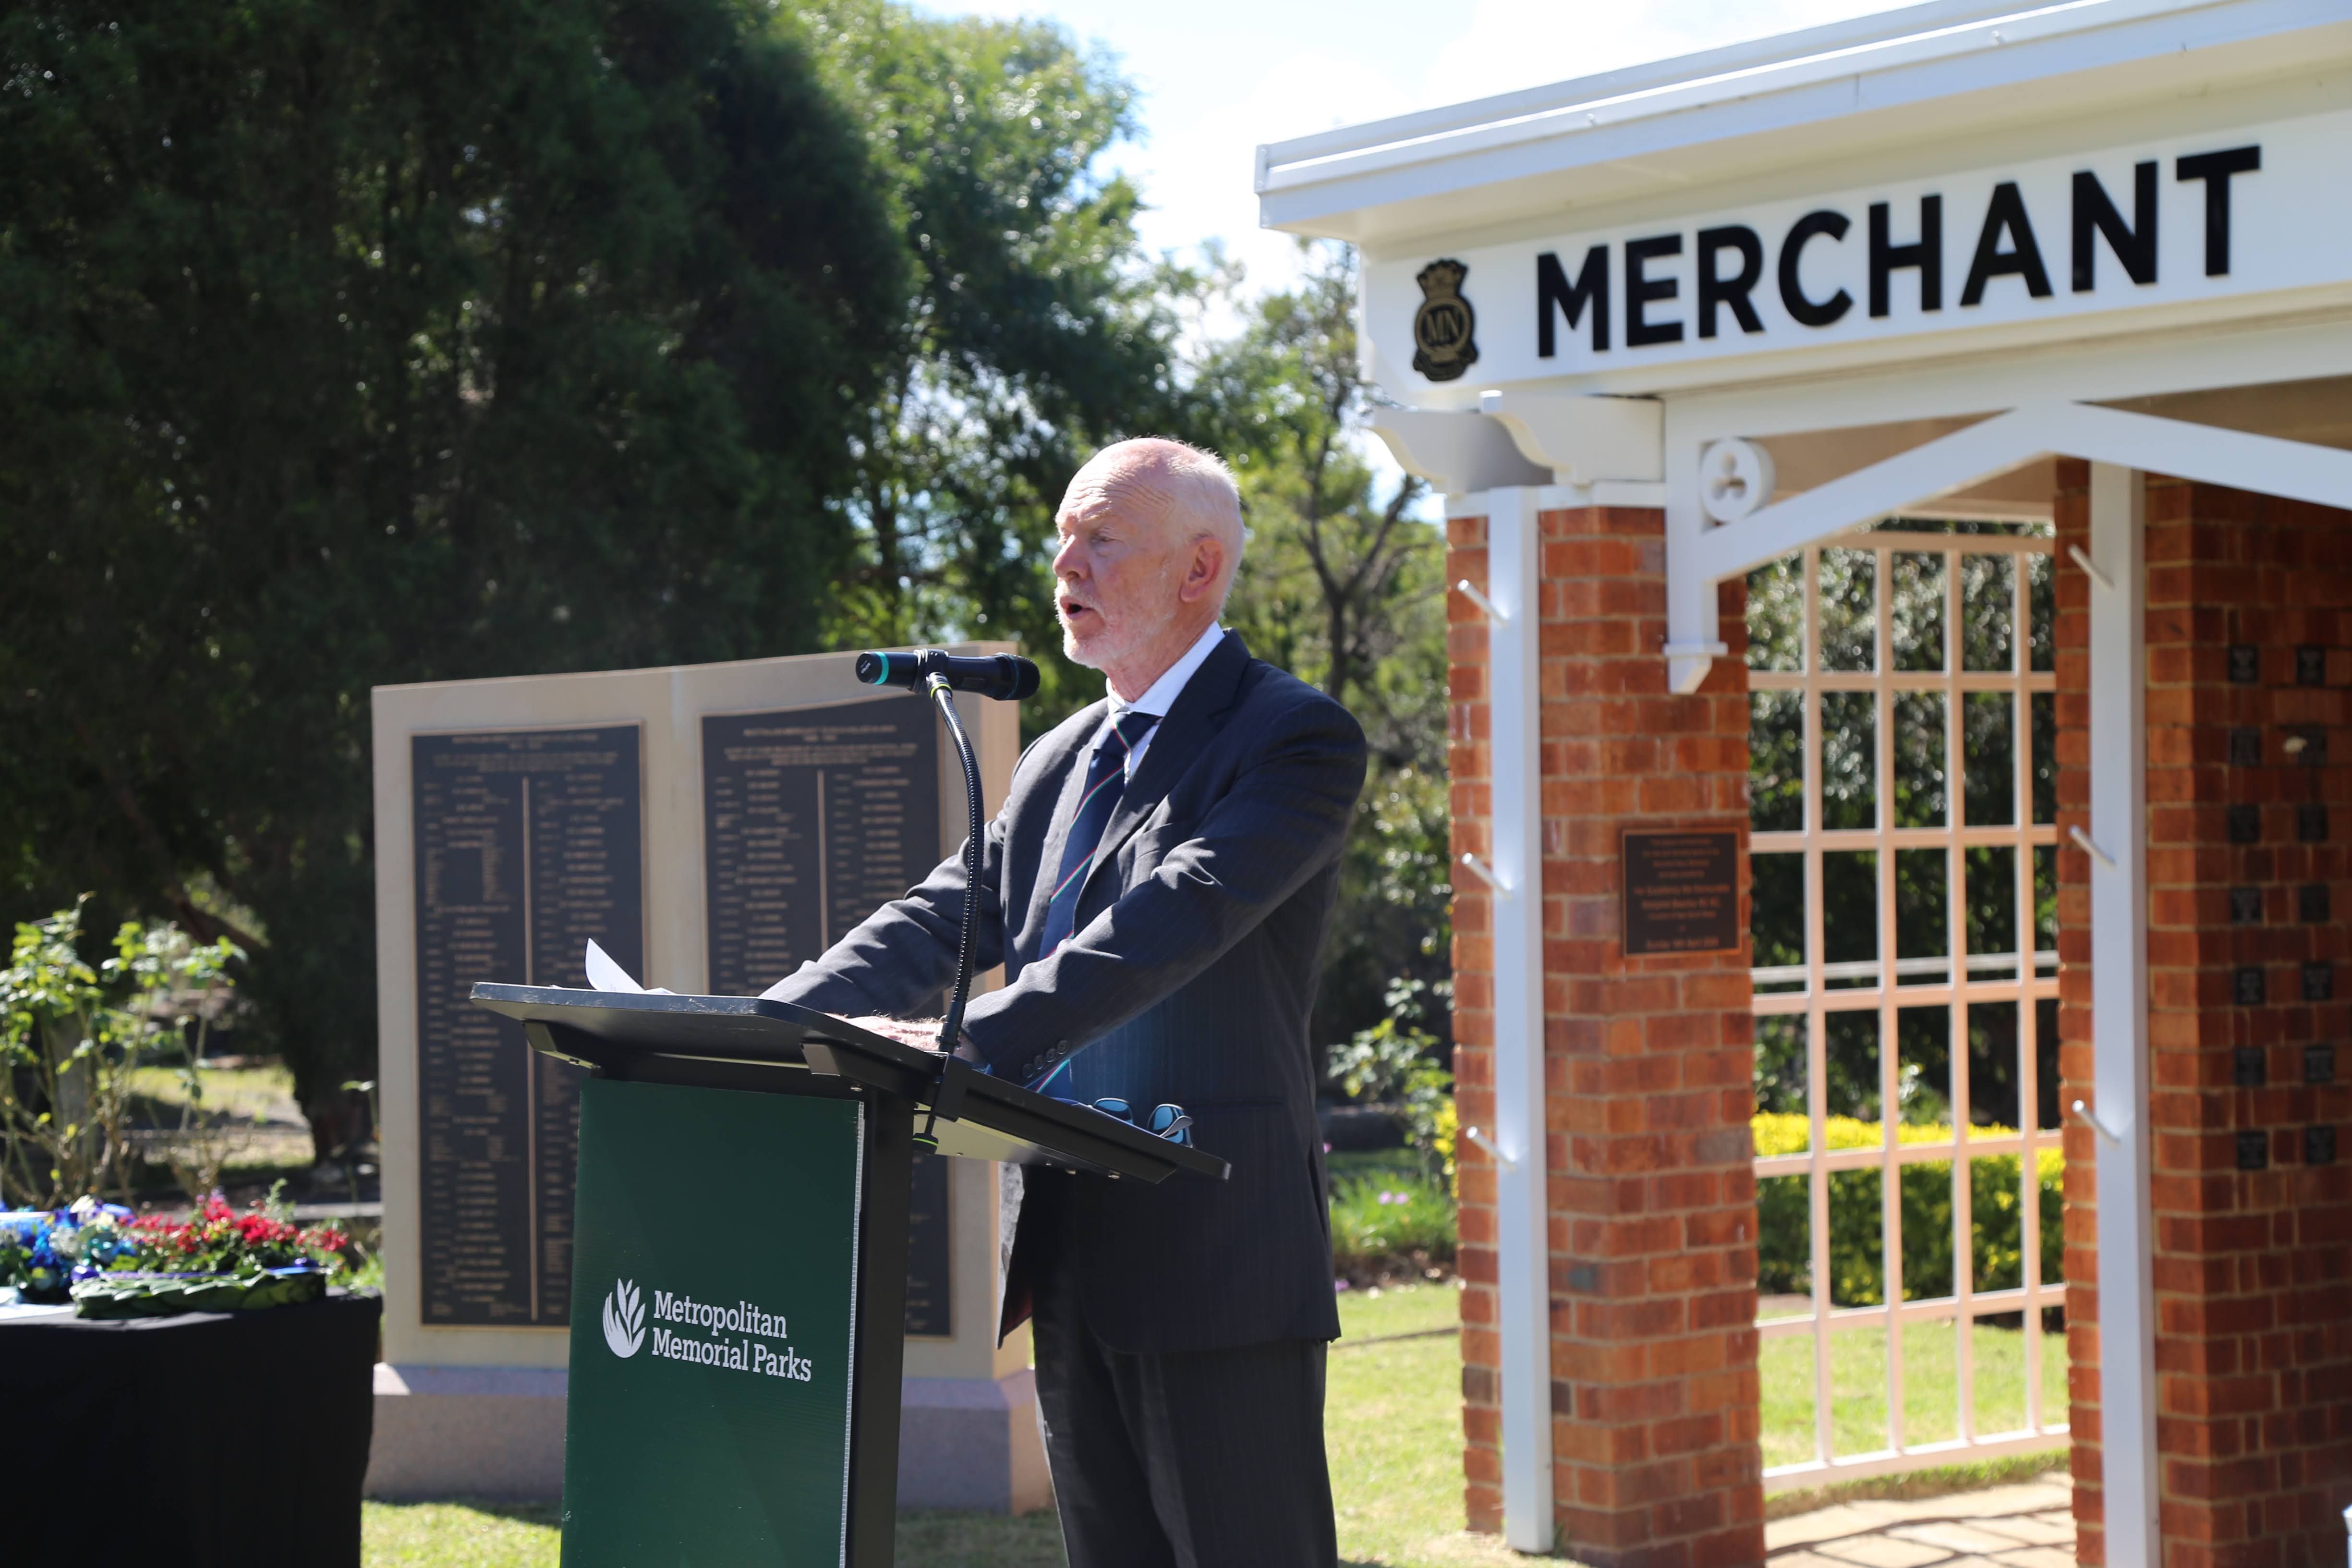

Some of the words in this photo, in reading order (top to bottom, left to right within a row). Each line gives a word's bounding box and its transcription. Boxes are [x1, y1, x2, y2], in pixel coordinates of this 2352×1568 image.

[1537, 145, 2260, 358] MERCHANT
[653, 1290, 787, 1339] Metropolitan
[652, 1327, 749, 1371] Memorial
[752, 1343, 812, 1382] Parks
